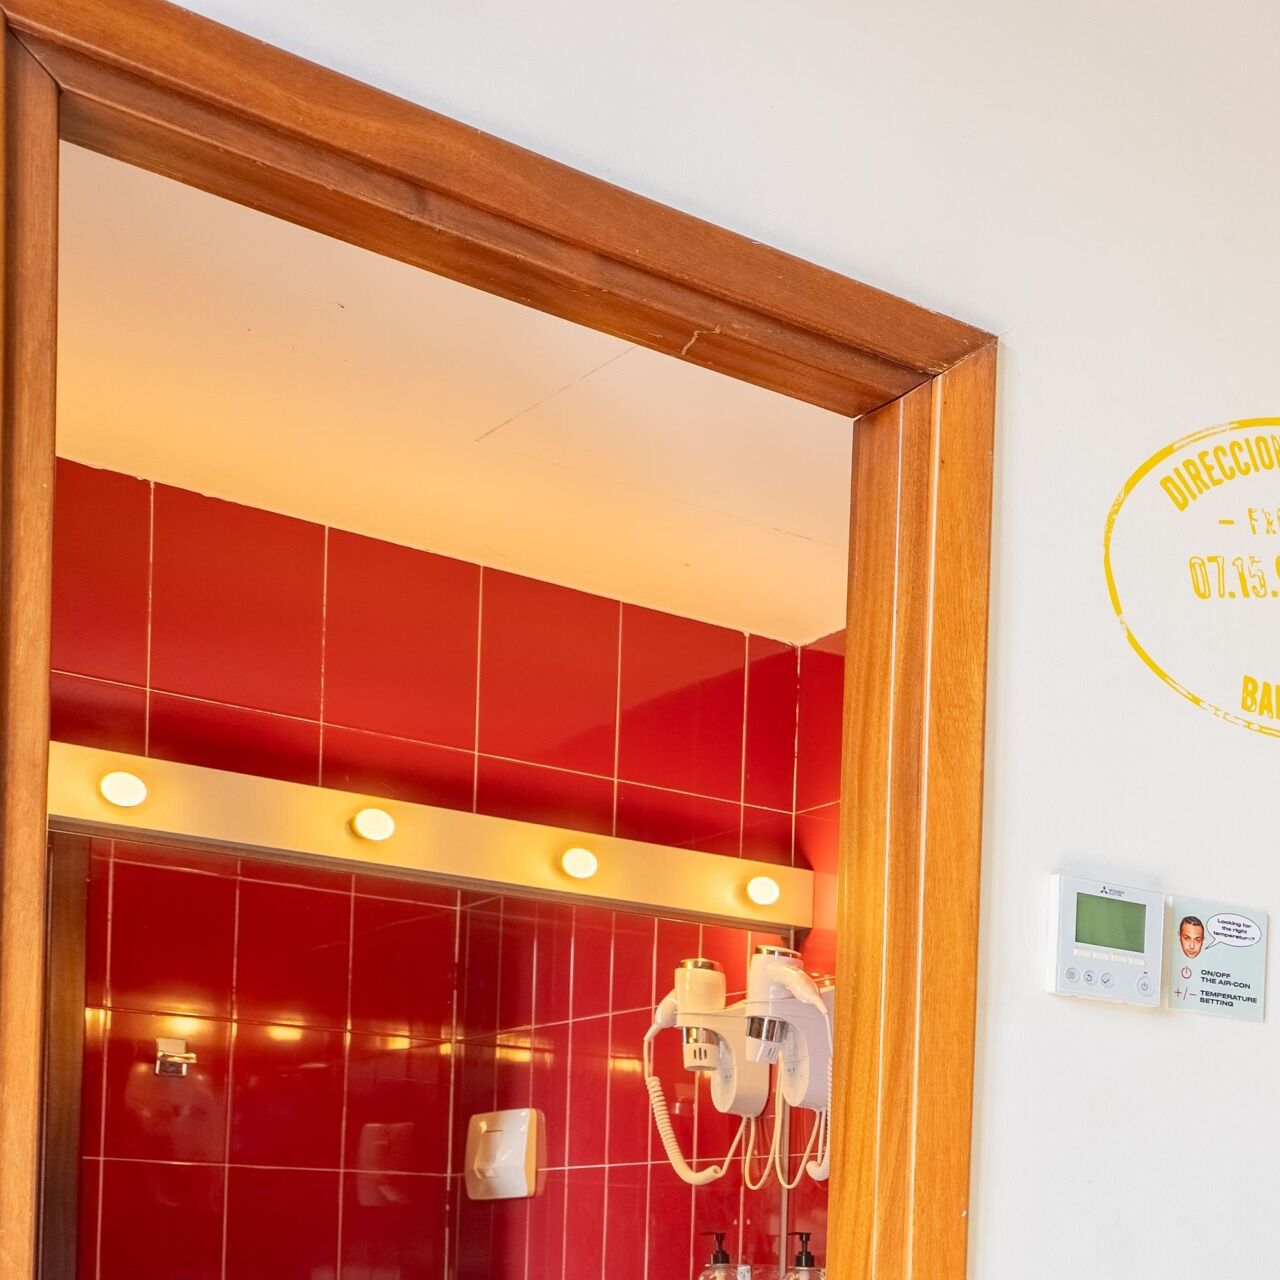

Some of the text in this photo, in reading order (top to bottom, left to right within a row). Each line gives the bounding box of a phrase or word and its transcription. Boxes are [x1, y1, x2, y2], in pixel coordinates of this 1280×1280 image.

[1200, 969, 1231, 980] ON/OFF
[1200, 977, 1251, 990] THE AIR-CON
[1199, 997, 1234, 1007] SETTING
[1200, 990, 1258, 1004] TEMPERATURE
